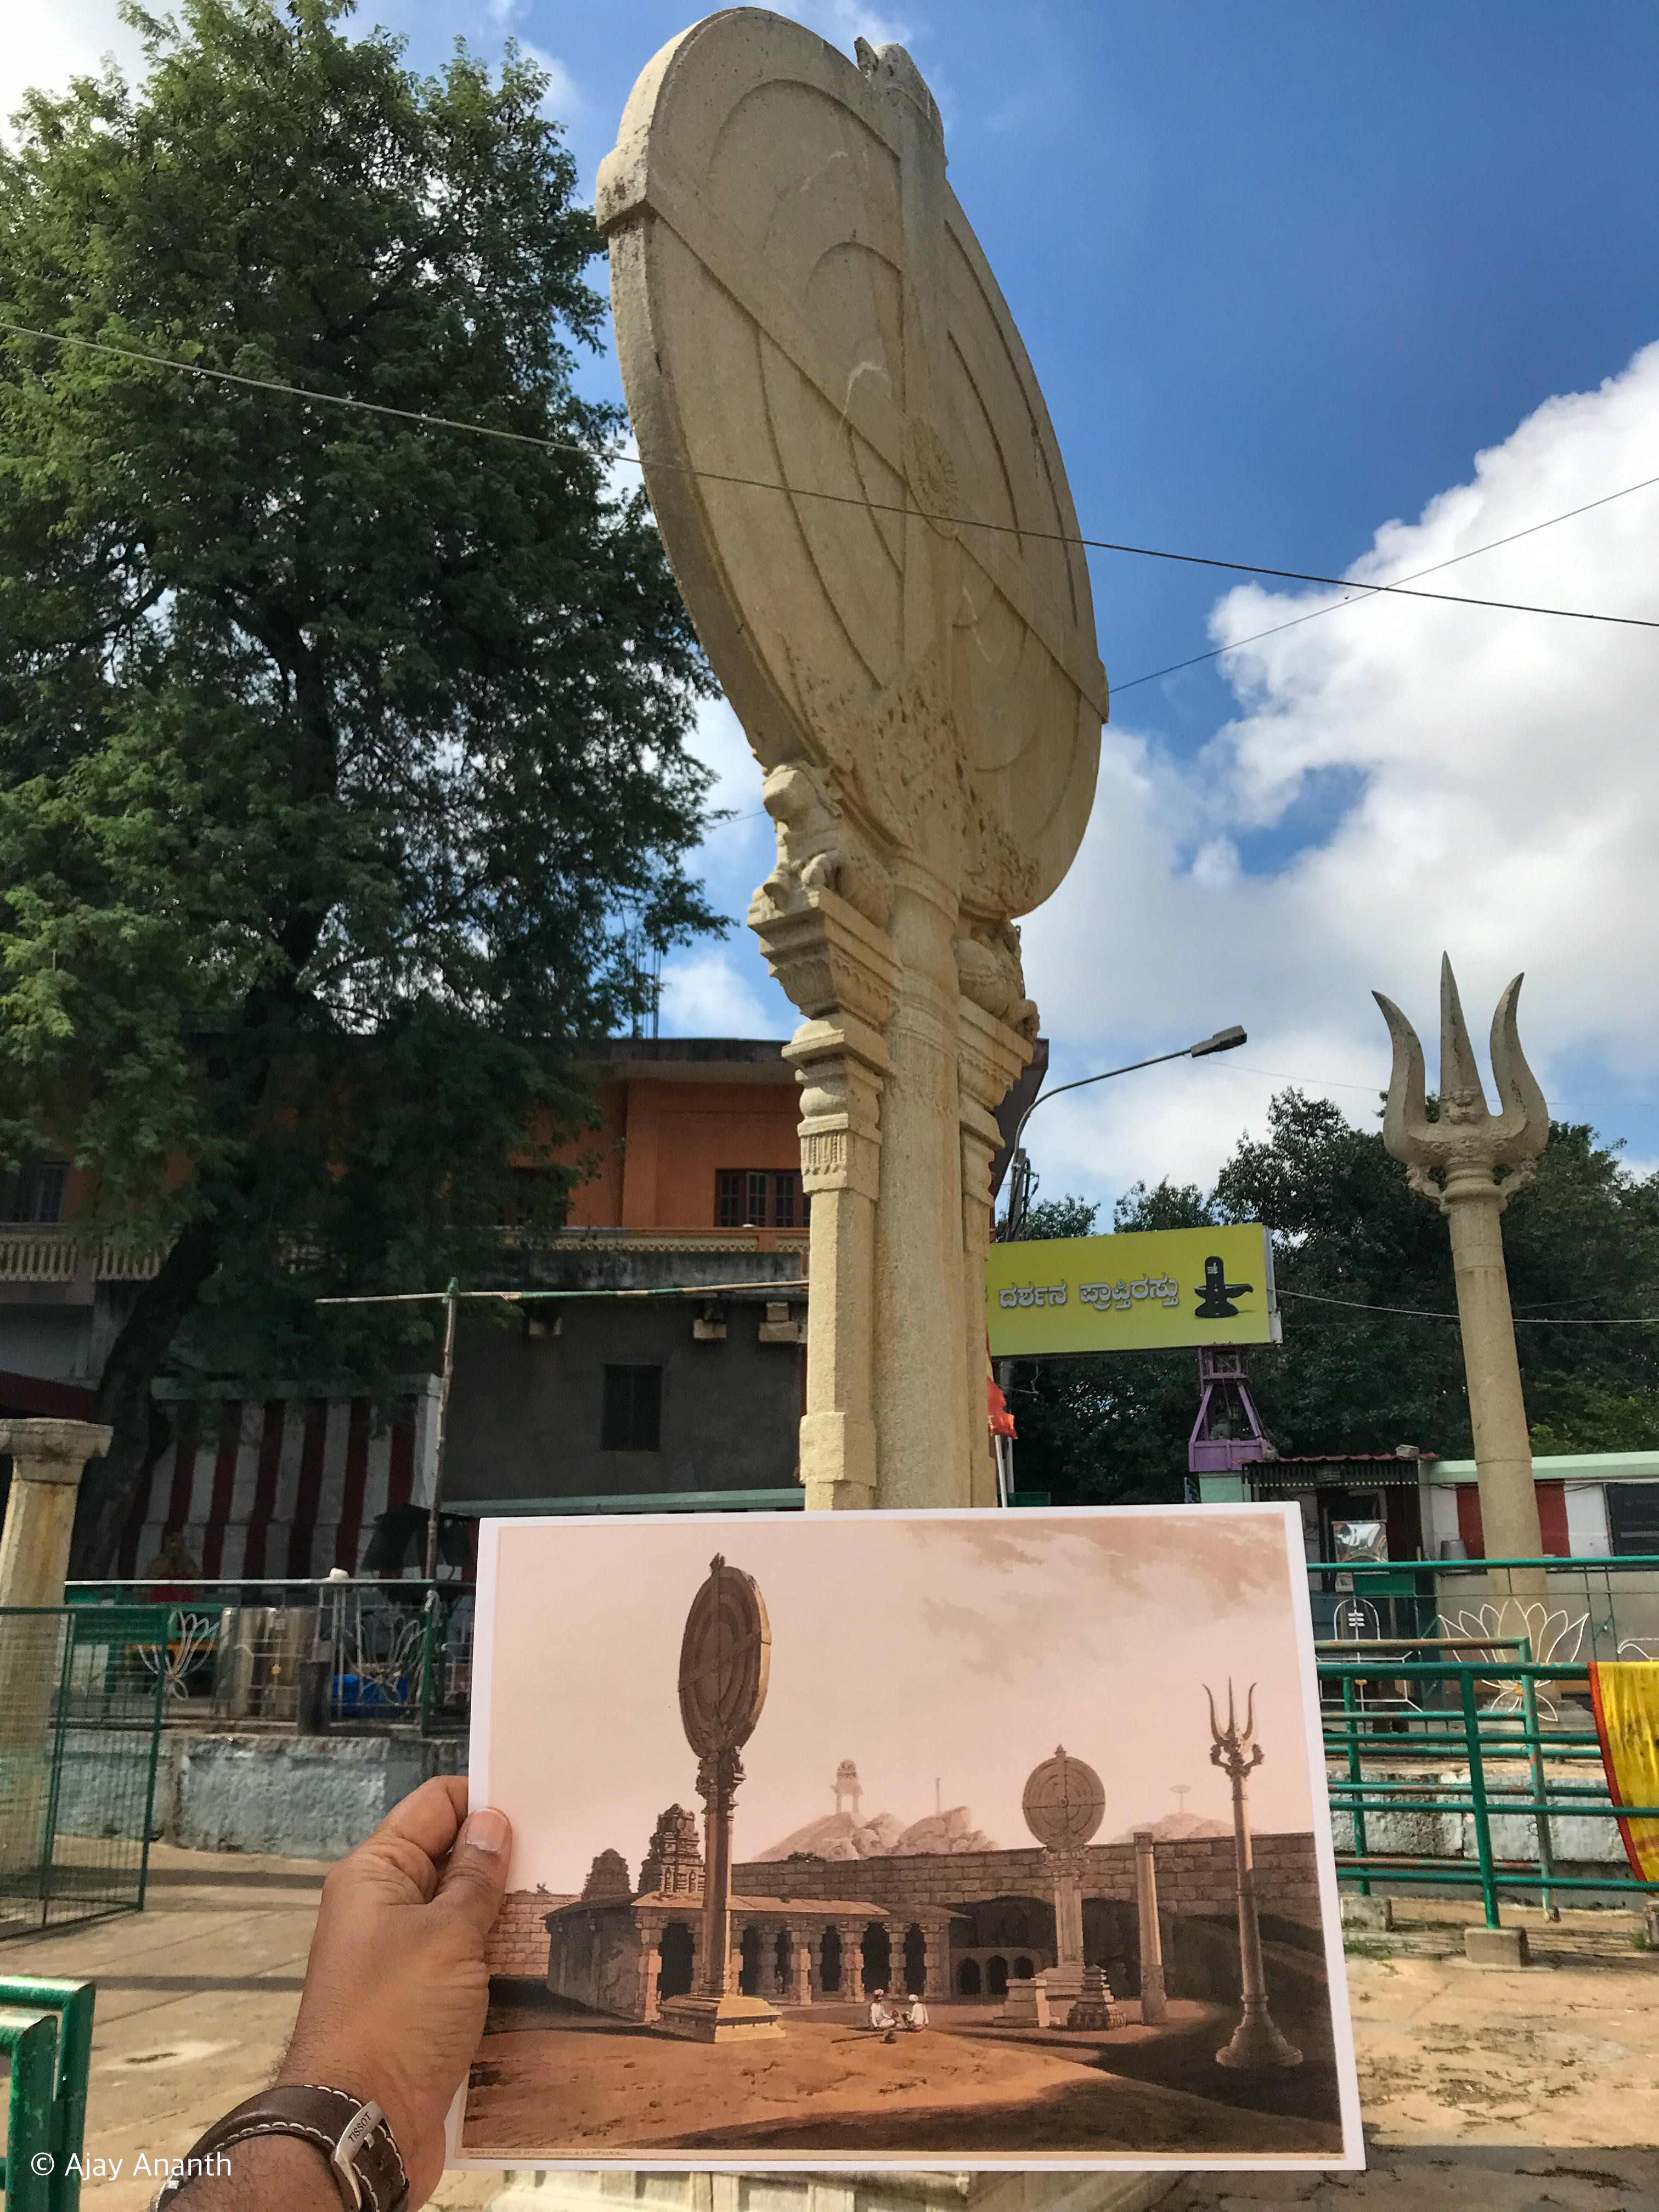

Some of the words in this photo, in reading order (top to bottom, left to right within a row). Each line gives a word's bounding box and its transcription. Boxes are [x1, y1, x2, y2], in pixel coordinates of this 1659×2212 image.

[1000, 1279, 1066, 1308] ದರ್ಶನ
[1080, 1272, 1179, 1310] ಪ್ರಾಪ್ತಿರಸ್ತು
[348, 2111, 371, 2142] TISSOT
